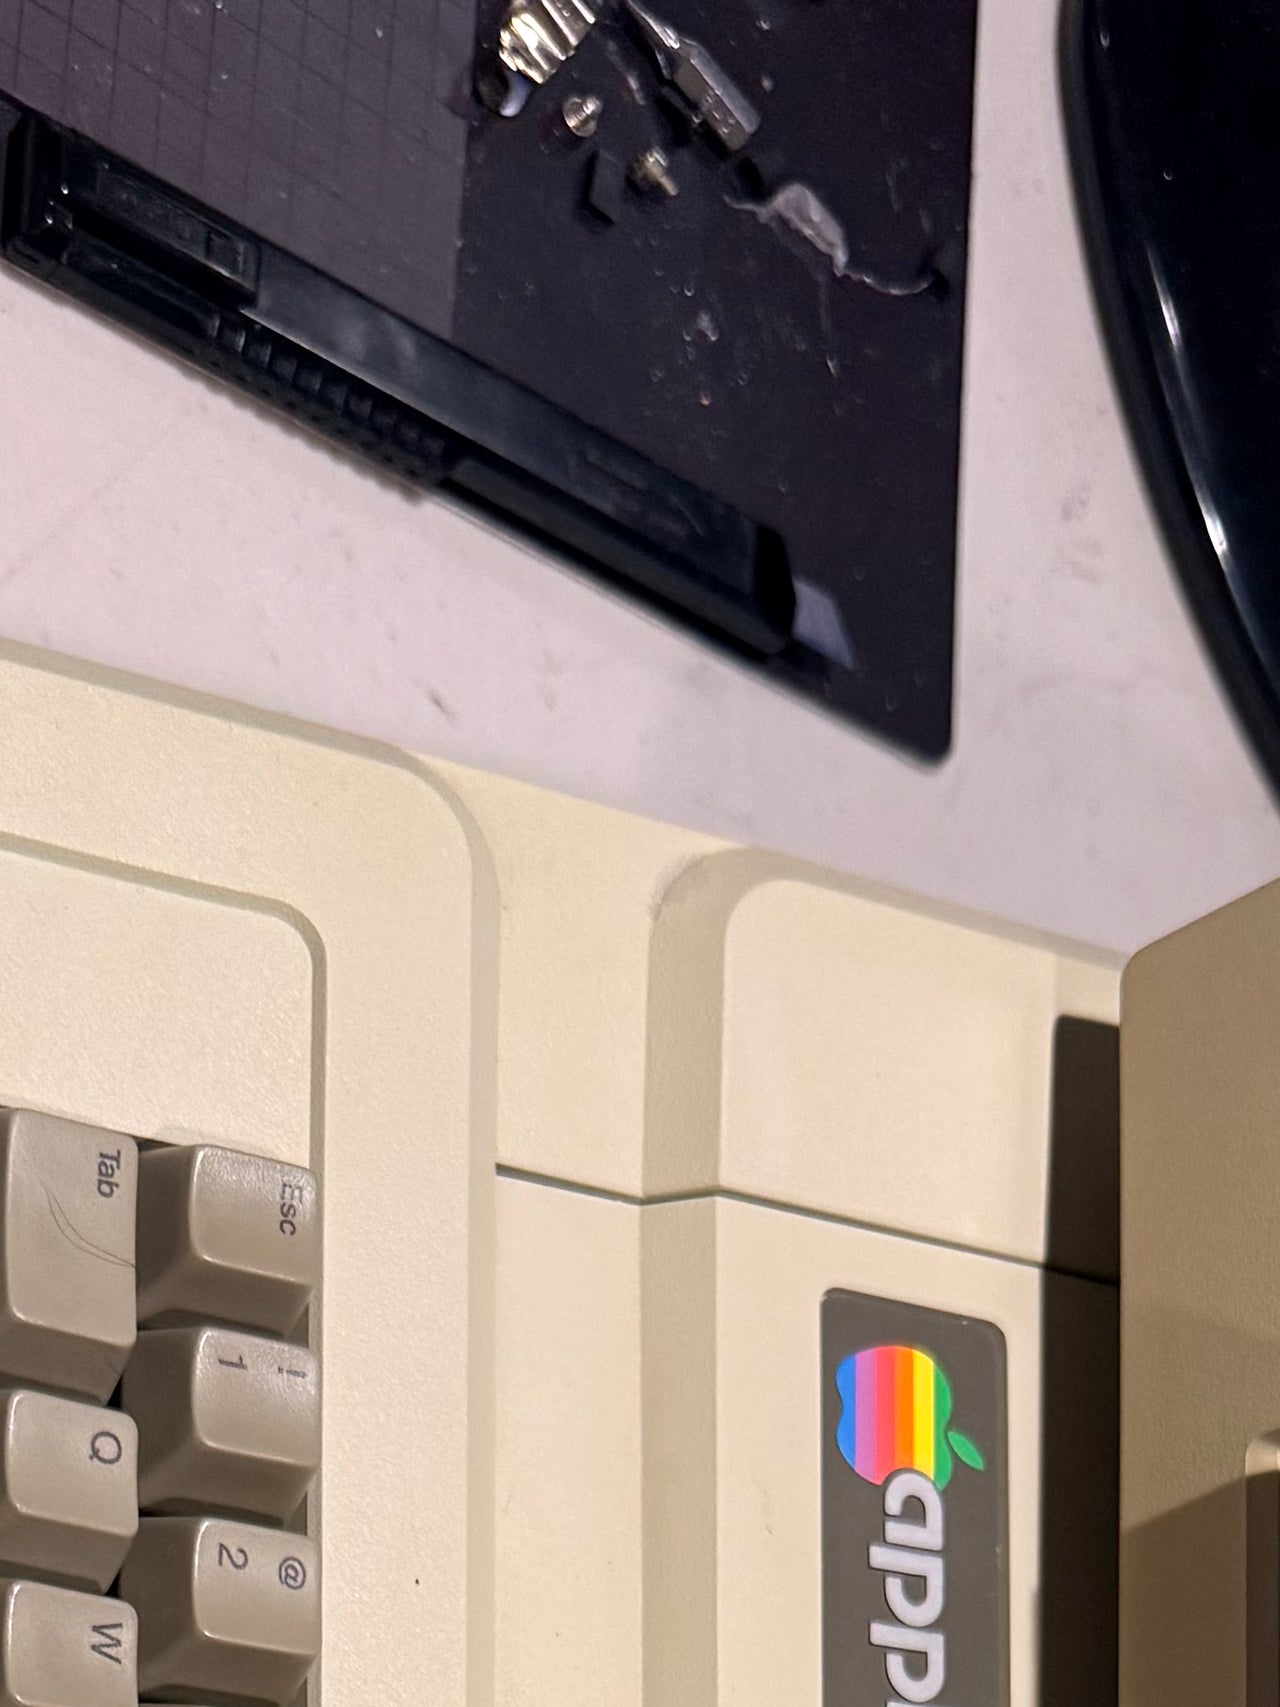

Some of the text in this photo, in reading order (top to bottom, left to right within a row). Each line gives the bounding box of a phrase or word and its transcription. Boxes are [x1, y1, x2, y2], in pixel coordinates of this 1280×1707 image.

[97, 1149, 121, 1198] Tab
[279, 1179, 306, 1236] Esc
[218, 1355, 247, 1370] 1
[277, 1365, 307, 1381] !
[89, 1431, 122, 1465] Q
[218, 1543, 248, 1569] 2
[278, 1556, 307, 1590] @
[90, 1623, 122, 1664] W
